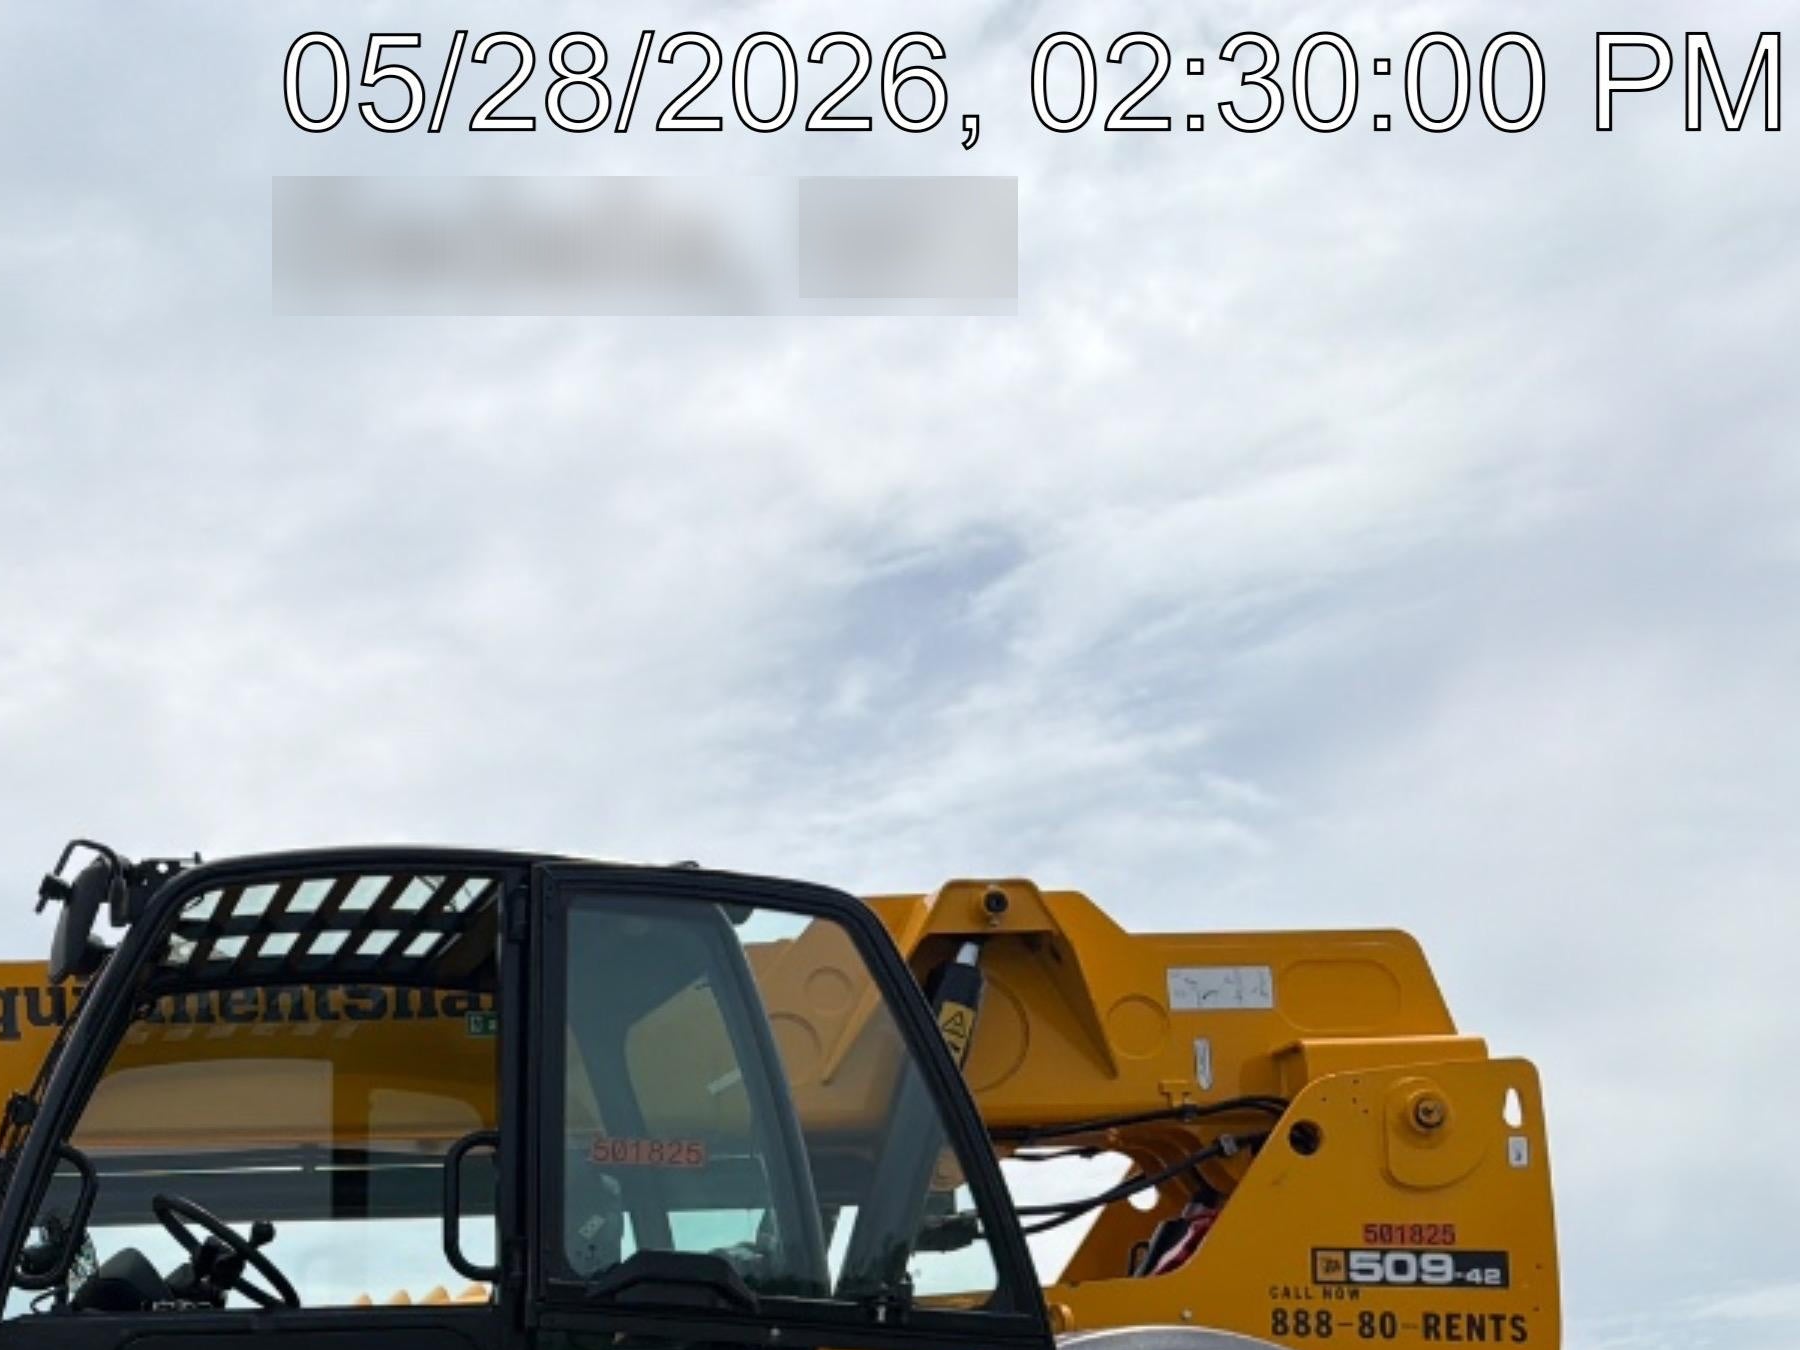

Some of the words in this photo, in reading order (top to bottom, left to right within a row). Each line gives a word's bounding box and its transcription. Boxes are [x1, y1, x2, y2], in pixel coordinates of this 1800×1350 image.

[592, 1140, 704, 1166] 501825
[1363, 1223, 1457, 1246] 501825
[1350, 1251, 1502, 1285] 509-42
[1269, 1285, 1313, 1300] CALL
[1322, 1286, 1361, 1300] NOW
[1270, 1307, 1529, 1343] 888-80-RENTS
